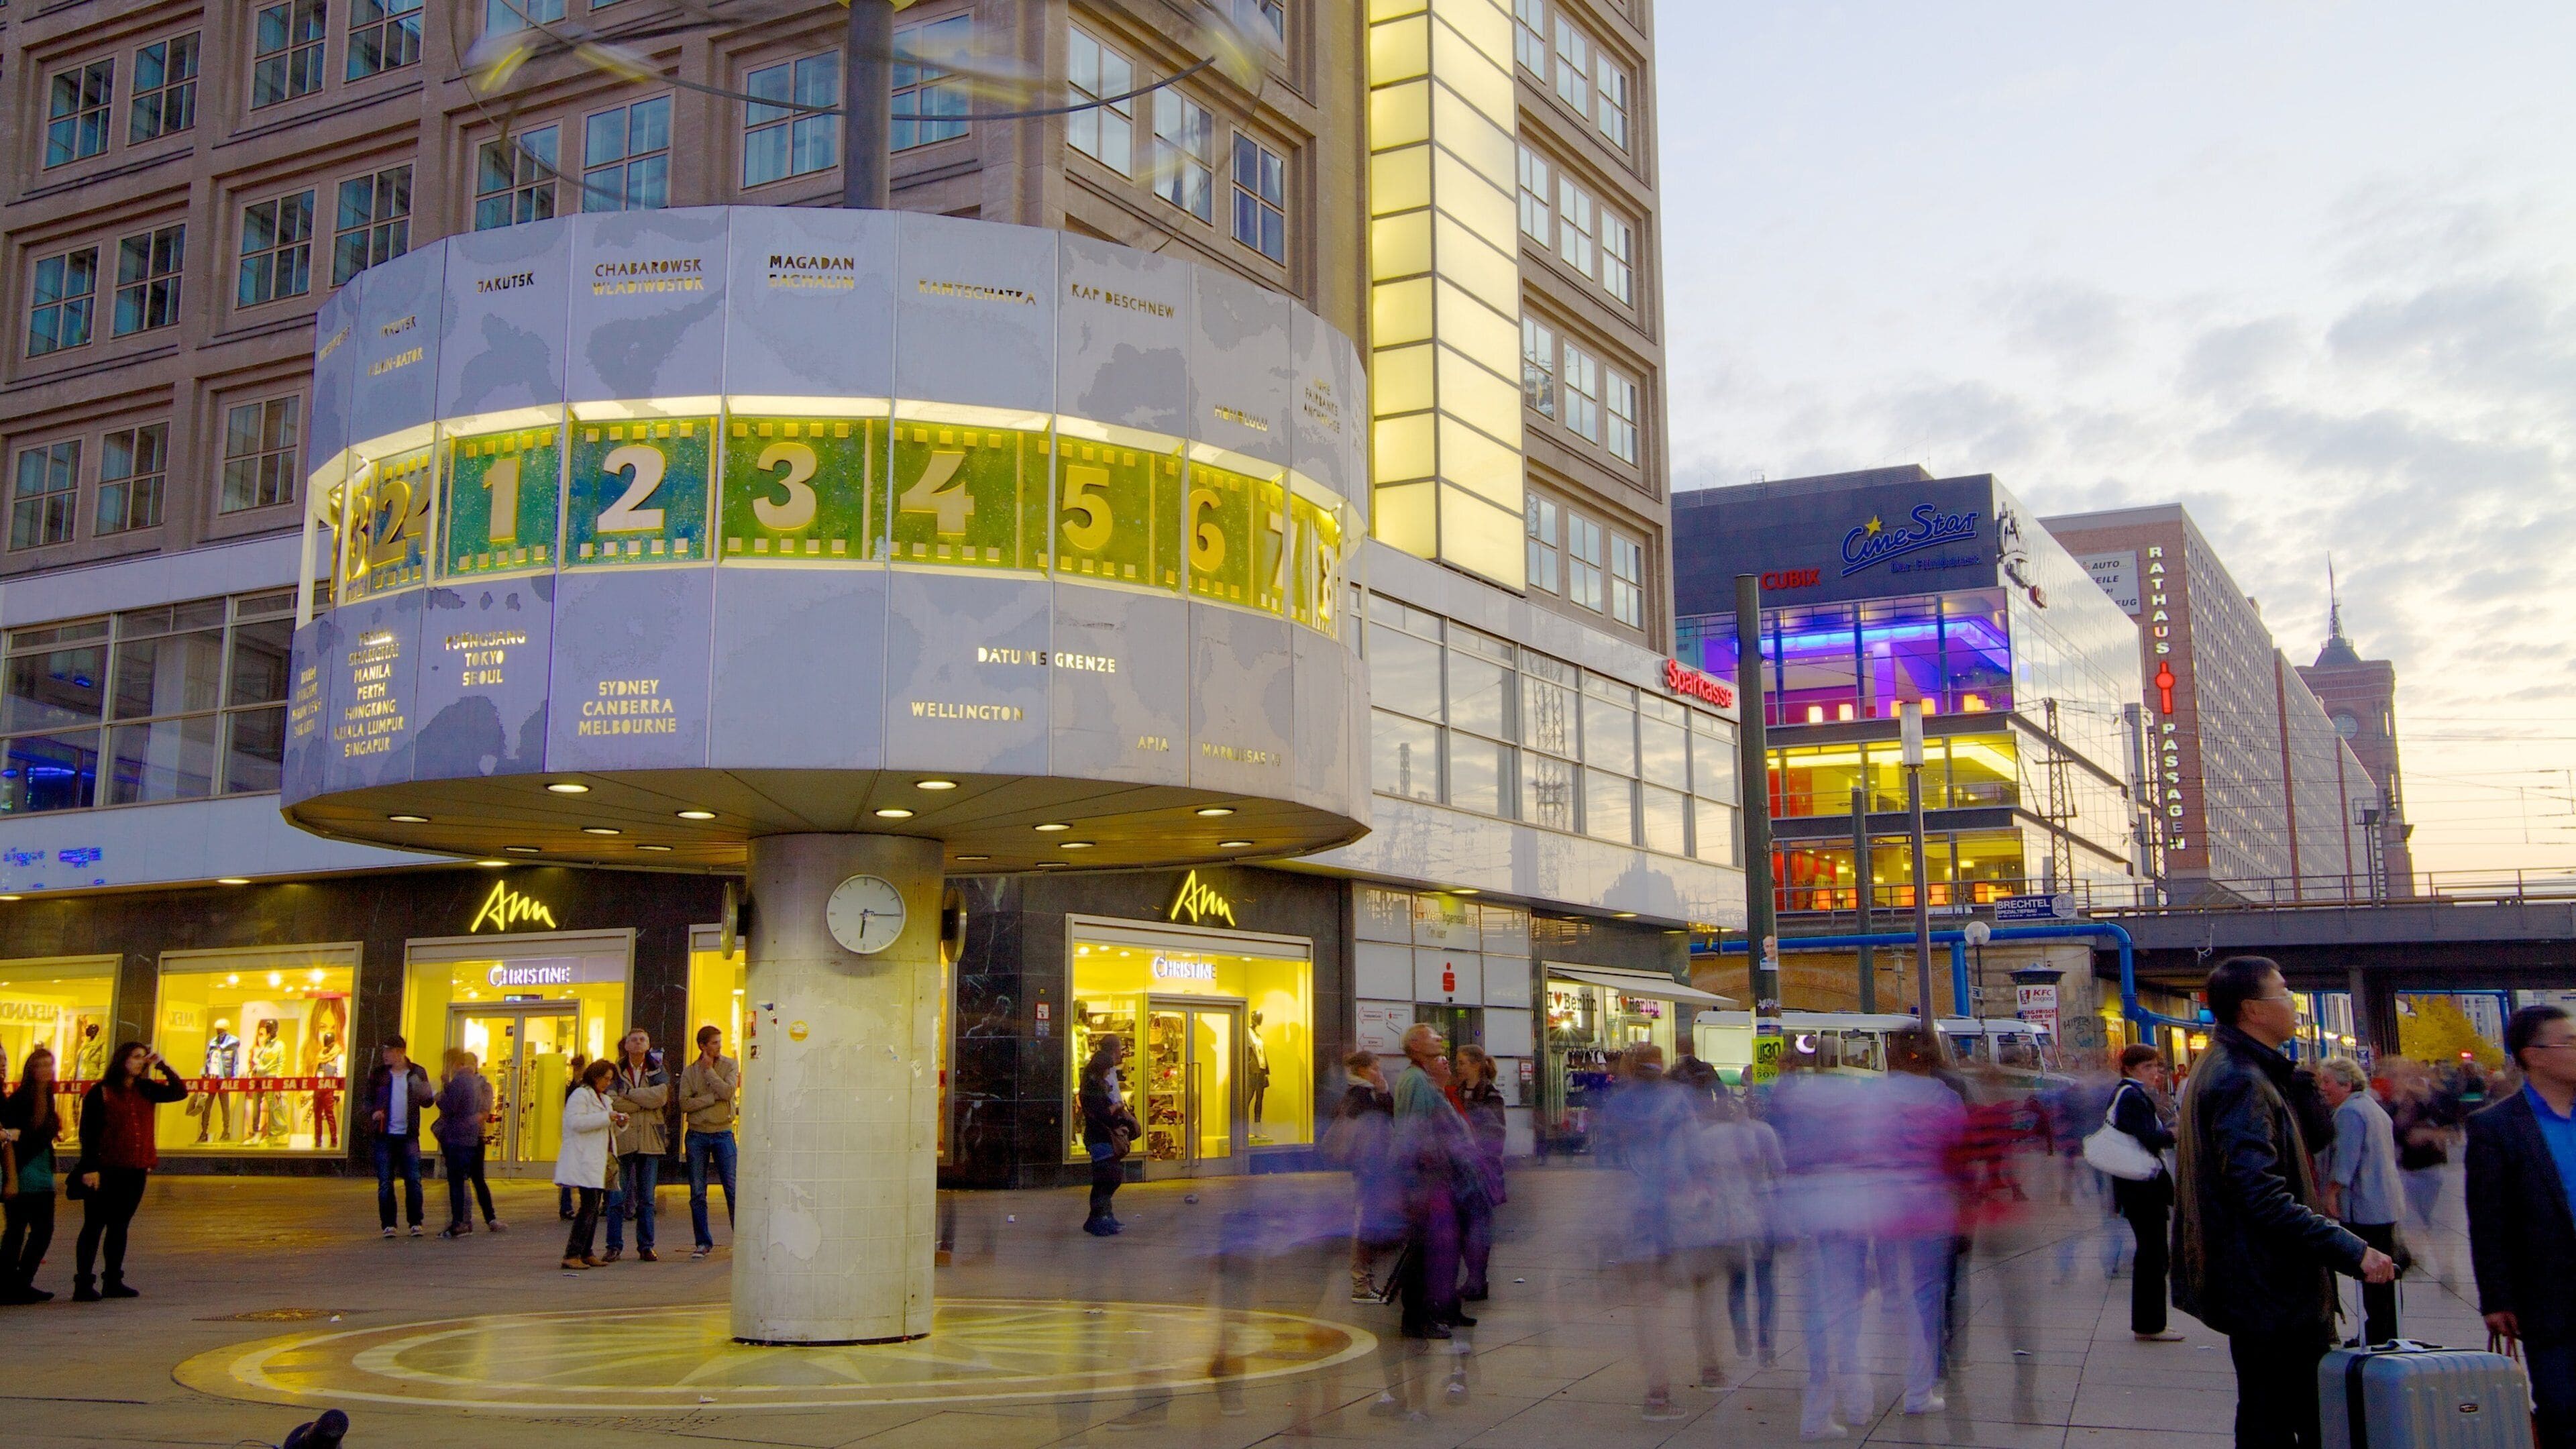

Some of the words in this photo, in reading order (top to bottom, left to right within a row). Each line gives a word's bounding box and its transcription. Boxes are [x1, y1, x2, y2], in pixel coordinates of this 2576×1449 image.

[595, 259, 702, 277] CHABAROWSK
[769, 255, 854, 270] MAGADAN
[477, 272, 535, 293] JAKUTSK
[593, 277, 704, 295] WLADIWOSTOK
[768, 274, 855, 290] SACHALIN
[918, 278, 1036, 306] KAMTSCHATKA
[1071, 283, 1100, 301] KAP
[1105, 291, 1175, 319] DESCHNEW
[1214, 404, 1269, 432] HONOLULU
[483, 457, 520, 542] 1
[597, 444, 666, 533] 2
[753, 442, 818, 531] 3
[900, 451, 975, 535] 4
[1061, 465, 1113, 550] 5
[1188, 488, 1226, 572] 6
[1318, 543, 1336, 621] 8
[1841, 504, 1979, 565] CineStar
[1760, 568, 1821, 590] CUBIX
[2092, 576, 2119, 584] EILE
[2149, 546, 2170, 655] RATHAUS
[464, 650, 504, 667] TOKYO
[354, 663, 391, 683] MANILA
[462, 669, 503, 686] SEOUL
[357, 682, 386, 700] PERTH
[598, 680, 659, 696] SYDNEY
[1668, 658, 1734, 708] Sparkasse
[345, 699, 396, 720] HONGKONG
[582, 698, 674, 716] CANBERRA
[911, 702, 1024, 721] WELLINGTON
[335, 722, 364, 740] KUALA
[368, 716, 404, 735] LUMPUR
[578, 718, 676, 736] MELBOURNE
[344, 737, 390, 757] SINGAPUR
[1138, 736, 1169, 751] APIA
[1997, 899, 2050, 909] BRECHTEL
[1564, 993, 1597, 1012] Berlin
[1629, 997, 1659, 1013] Berlin
